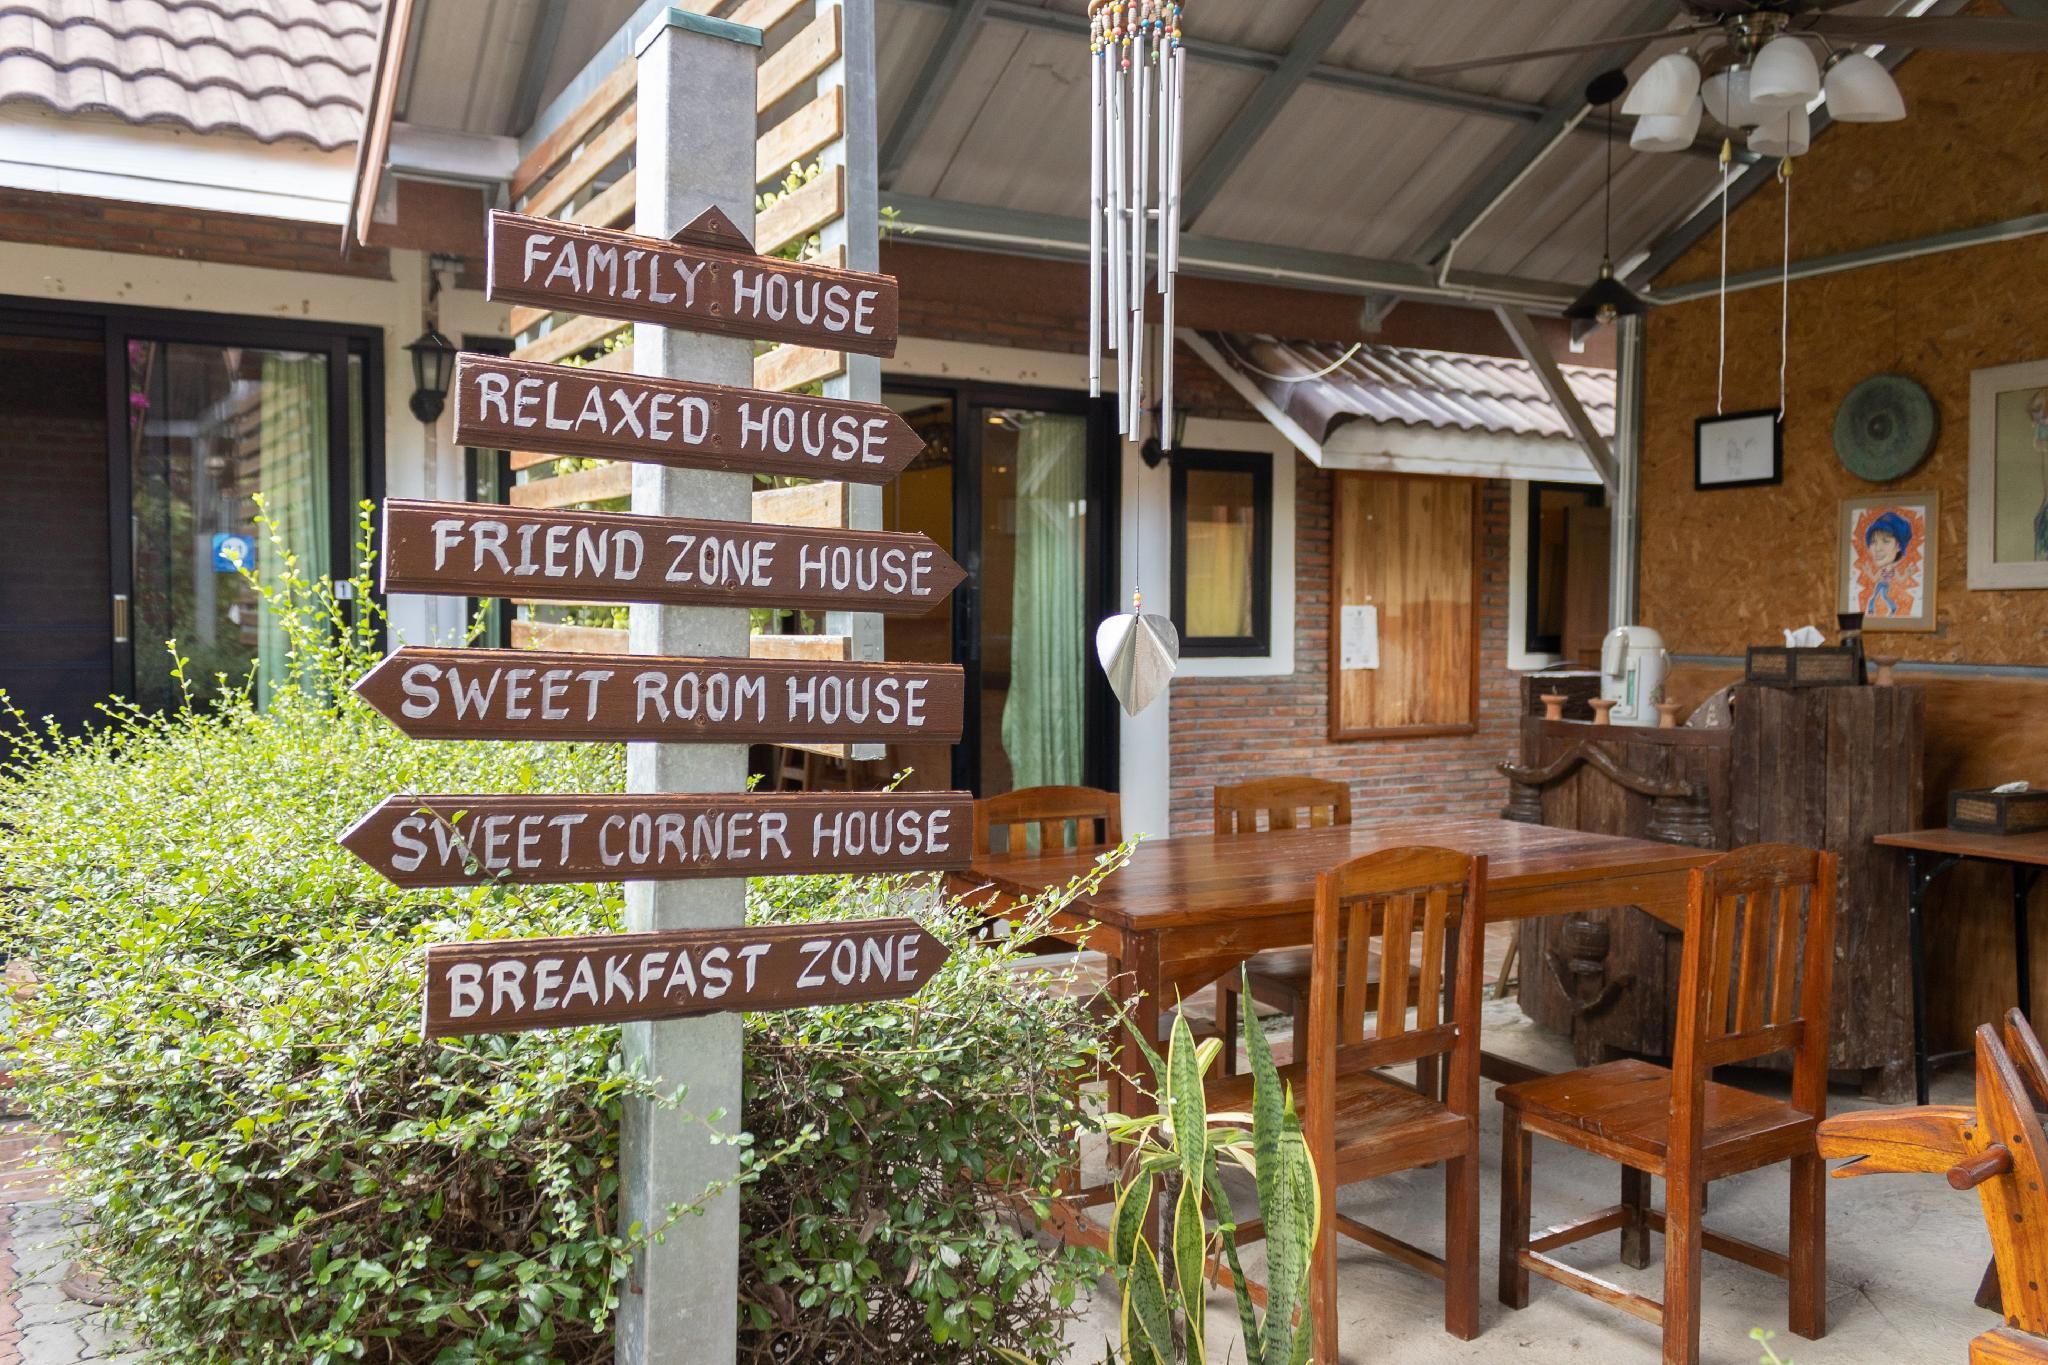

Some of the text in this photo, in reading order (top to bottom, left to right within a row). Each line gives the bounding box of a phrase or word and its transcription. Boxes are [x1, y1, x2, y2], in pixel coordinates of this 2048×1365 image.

[523, 234, 880, 335] FAMILY HOUSE
[474, 372, 889, 464] RELAXED HOUSE
[430, 518, 933, 596] FRIEND ZONE HOUSE
[401, 663, 929, 727] SWEET ROOM HOUSE
[391, 808, 951, 872] SWEET CORNER HOUSE
[445, 933, 921, 1019] BREAKFAST ZONE
